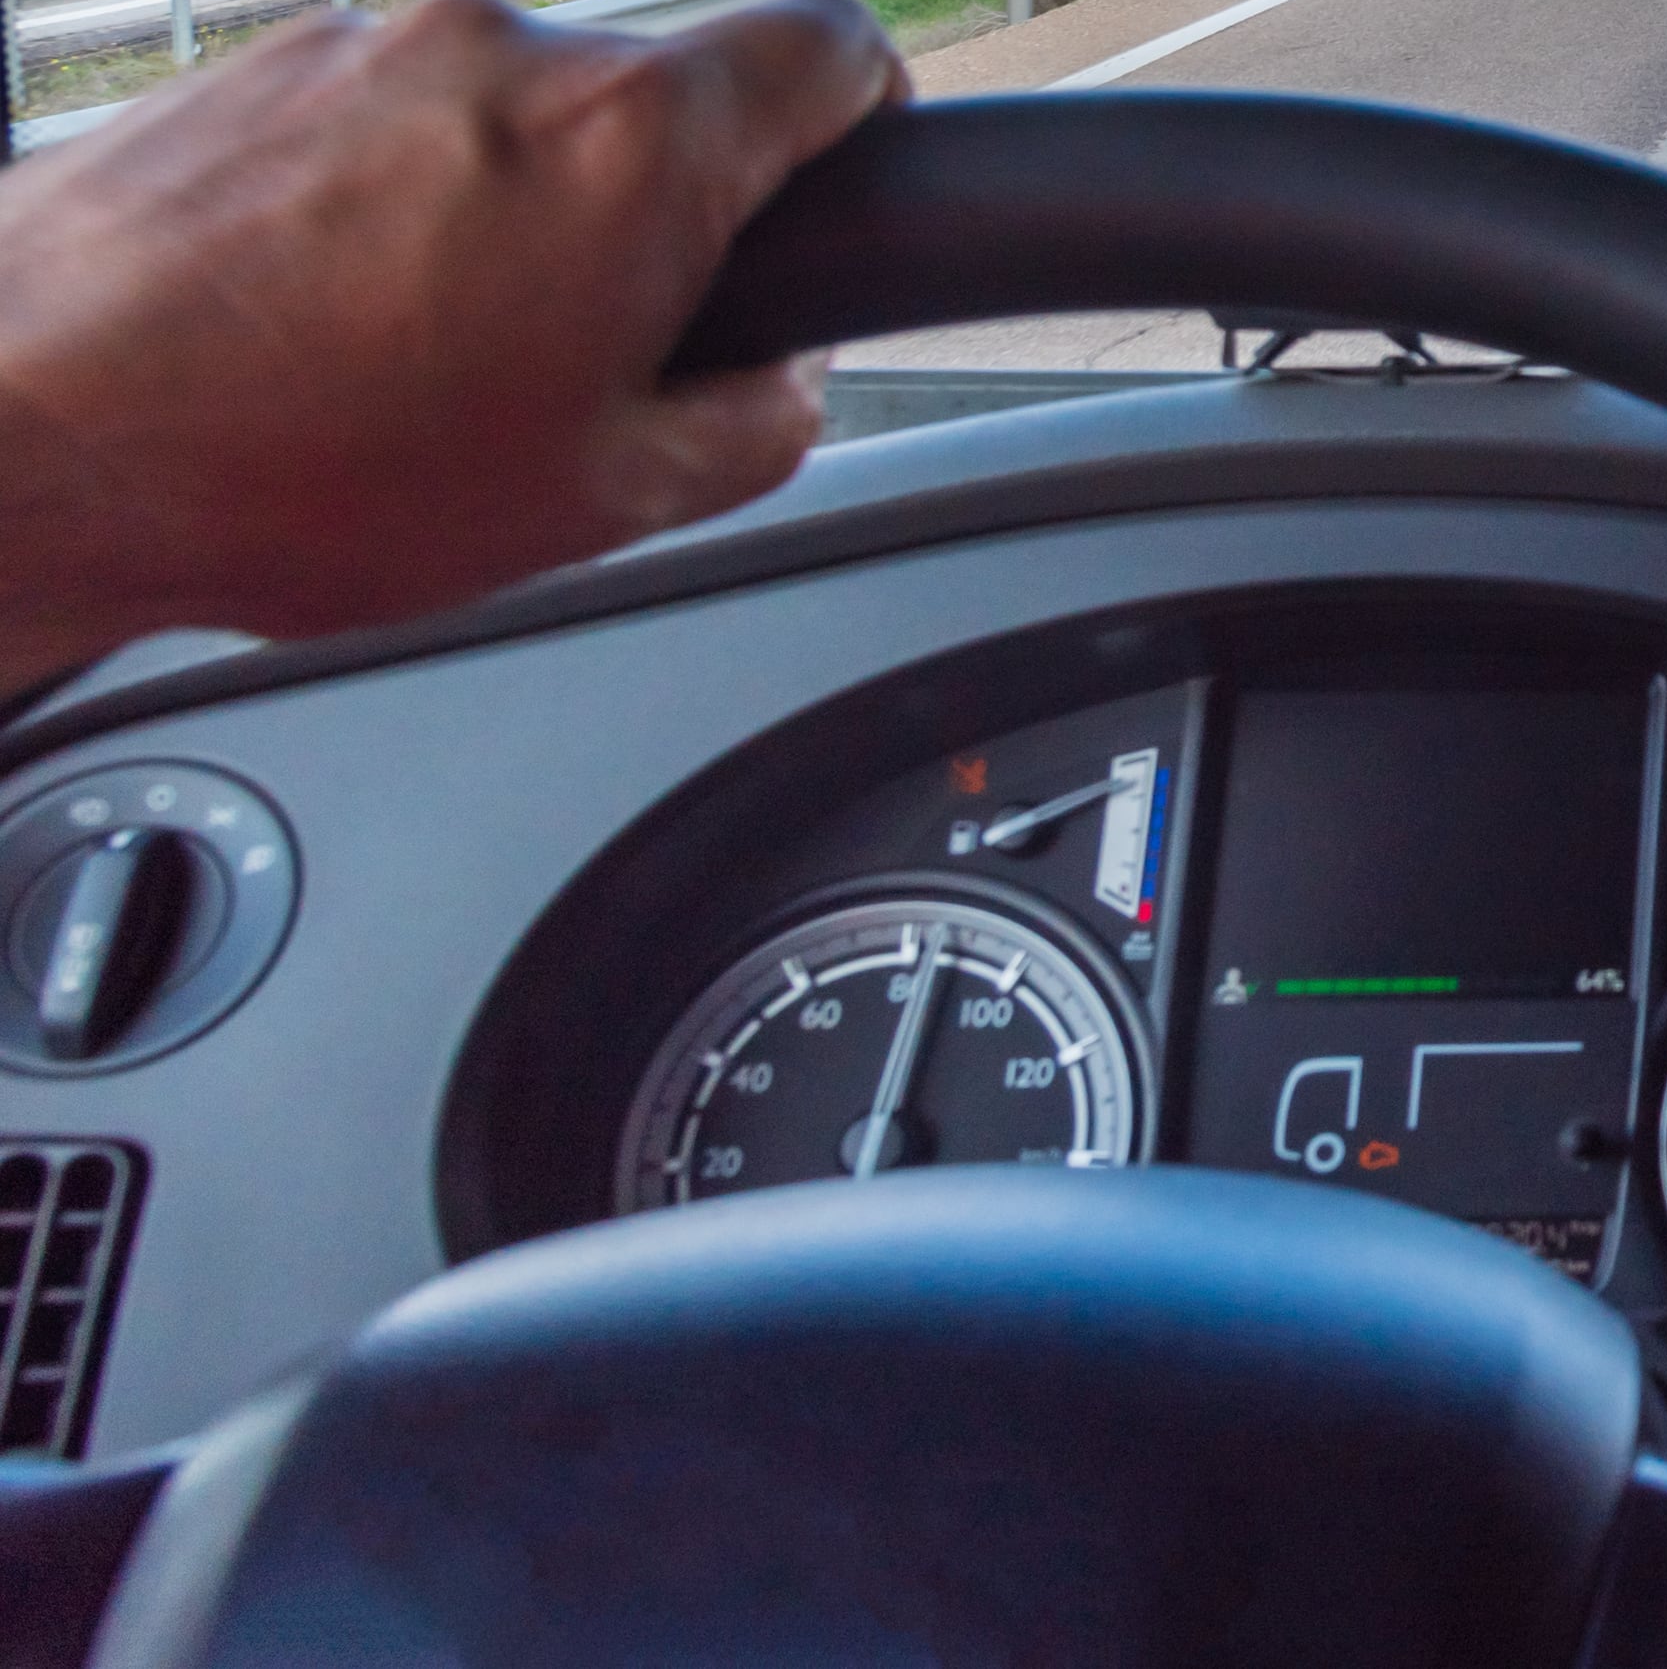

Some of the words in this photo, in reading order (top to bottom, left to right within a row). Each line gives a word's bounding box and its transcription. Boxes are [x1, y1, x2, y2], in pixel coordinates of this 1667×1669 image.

[800, 998, 843, 1030] 60
[959, 996, 1014, 1029] 100
[729, 1062, 773, 1094] 40
[1004, 1056, 1055, 1089] 120
[703, 1145, 744, 1179] 20
